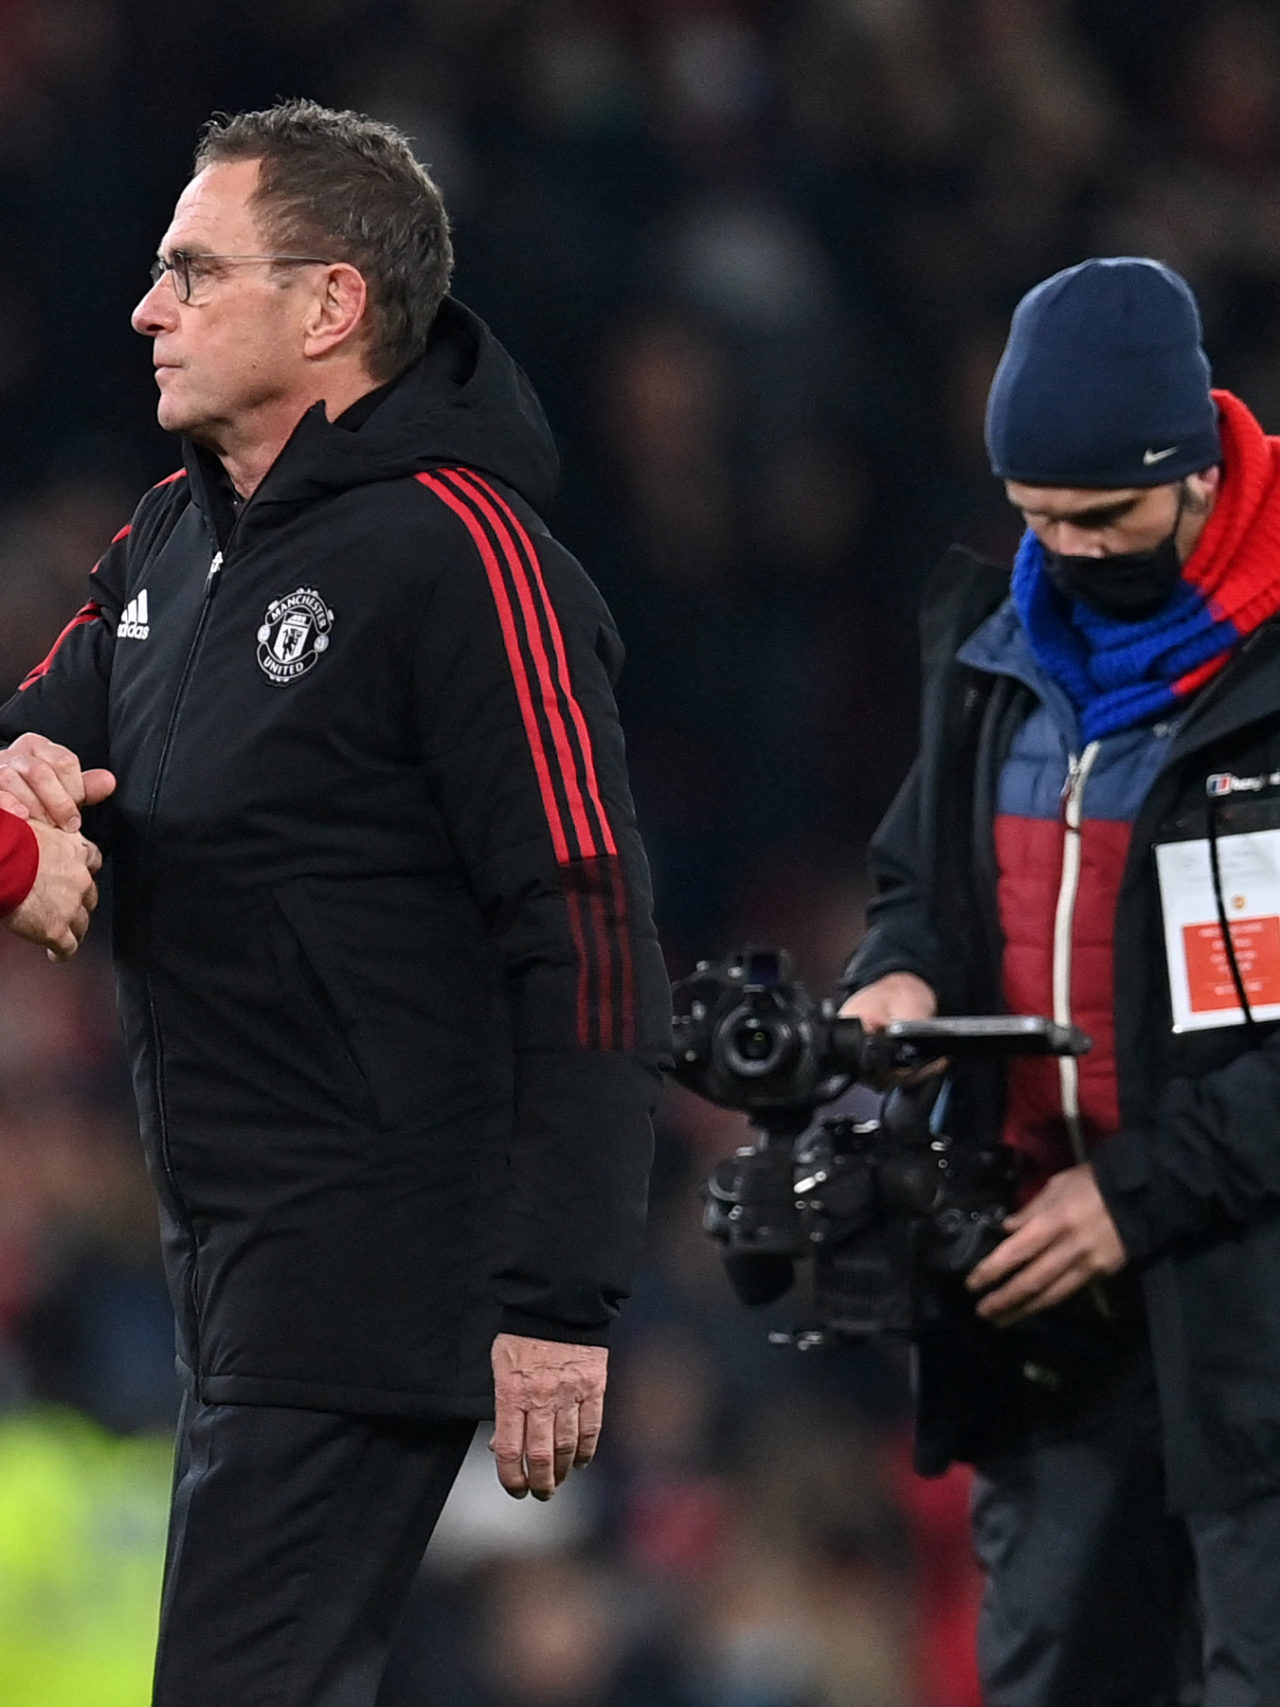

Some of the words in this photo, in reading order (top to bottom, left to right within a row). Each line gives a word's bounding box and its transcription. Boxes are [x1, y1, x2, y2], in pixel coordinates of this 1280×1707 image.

[271, 595, 327, 630] MANCHESTER
[116, 620, 150, 641] adidas
[263, 655, 304, 676] UNITED
